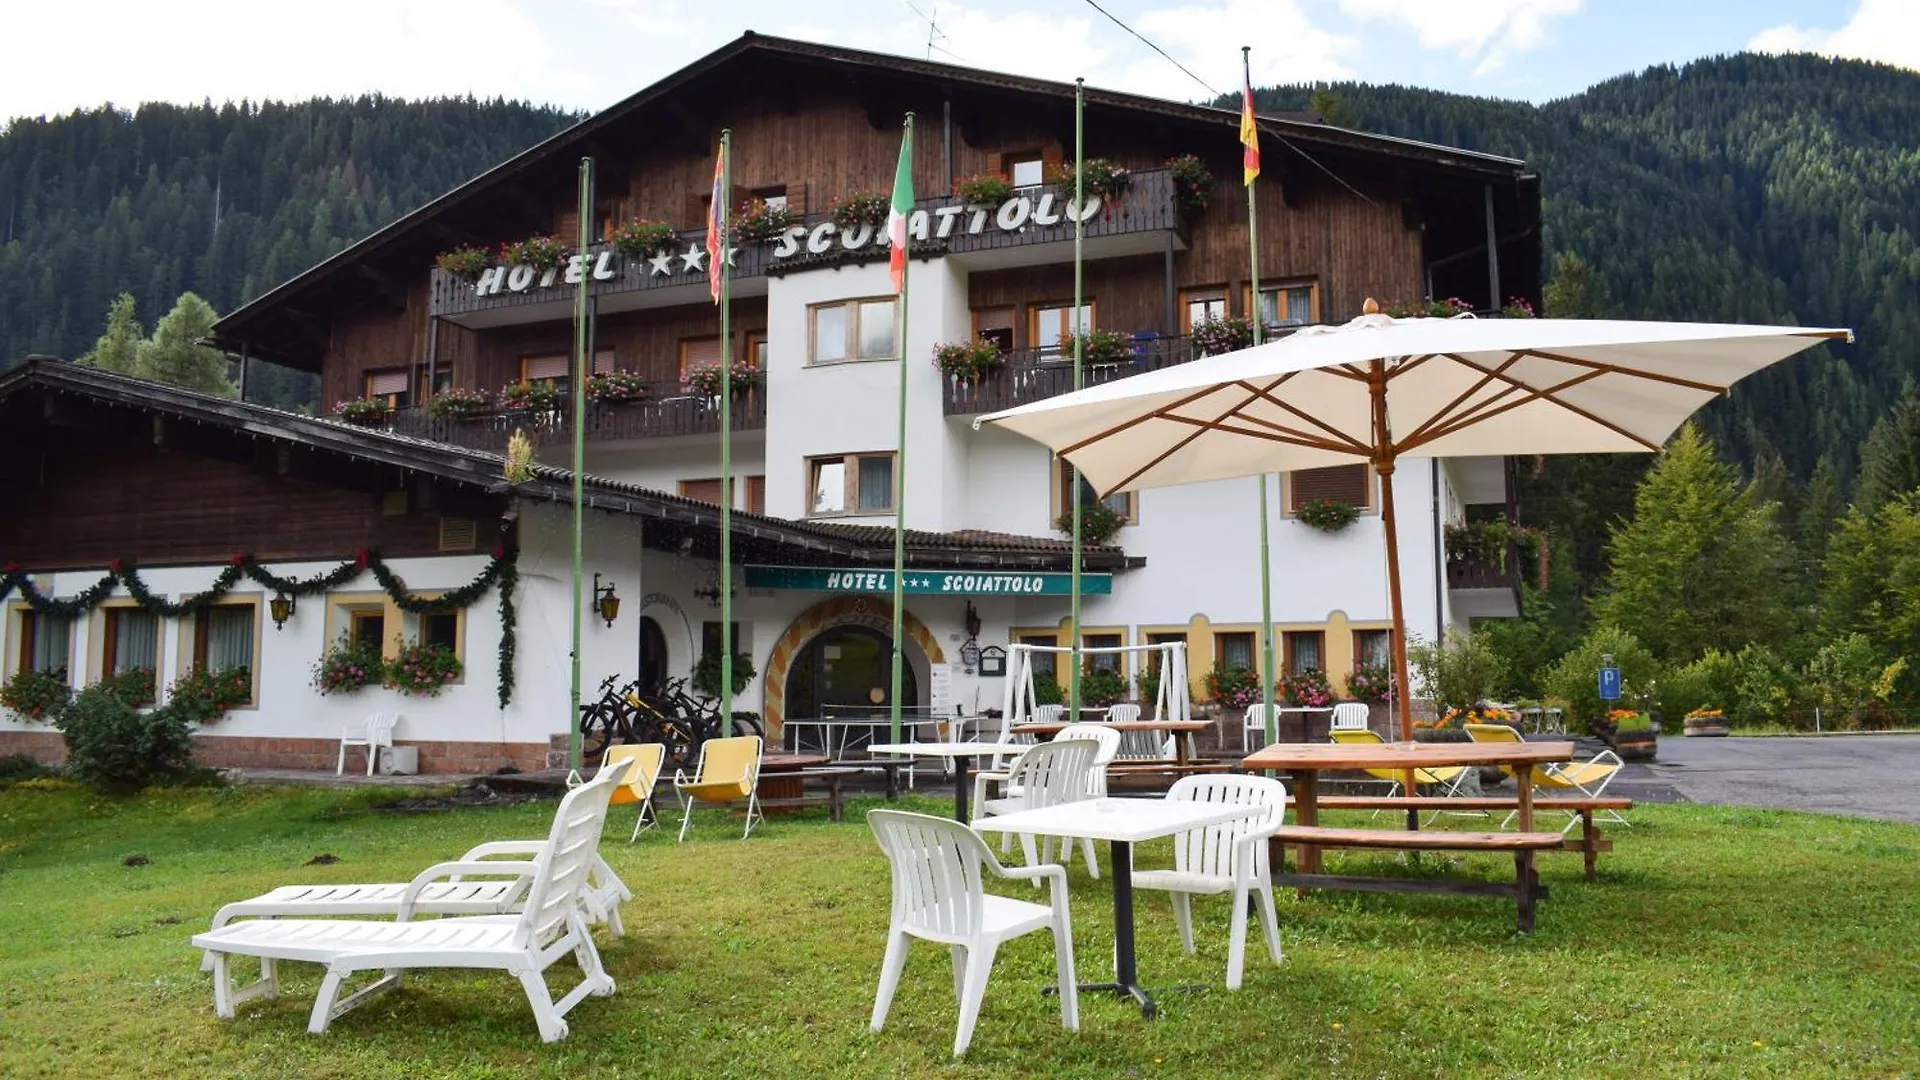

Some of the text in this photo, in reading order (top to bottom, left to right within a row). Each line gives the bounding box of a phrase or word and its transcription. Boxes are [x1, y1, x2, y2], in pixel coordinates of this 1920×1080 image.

[827, 573, 1045, 593] HOTEL SCOIATTOLO
[1604, 670, 1614, 685] P
